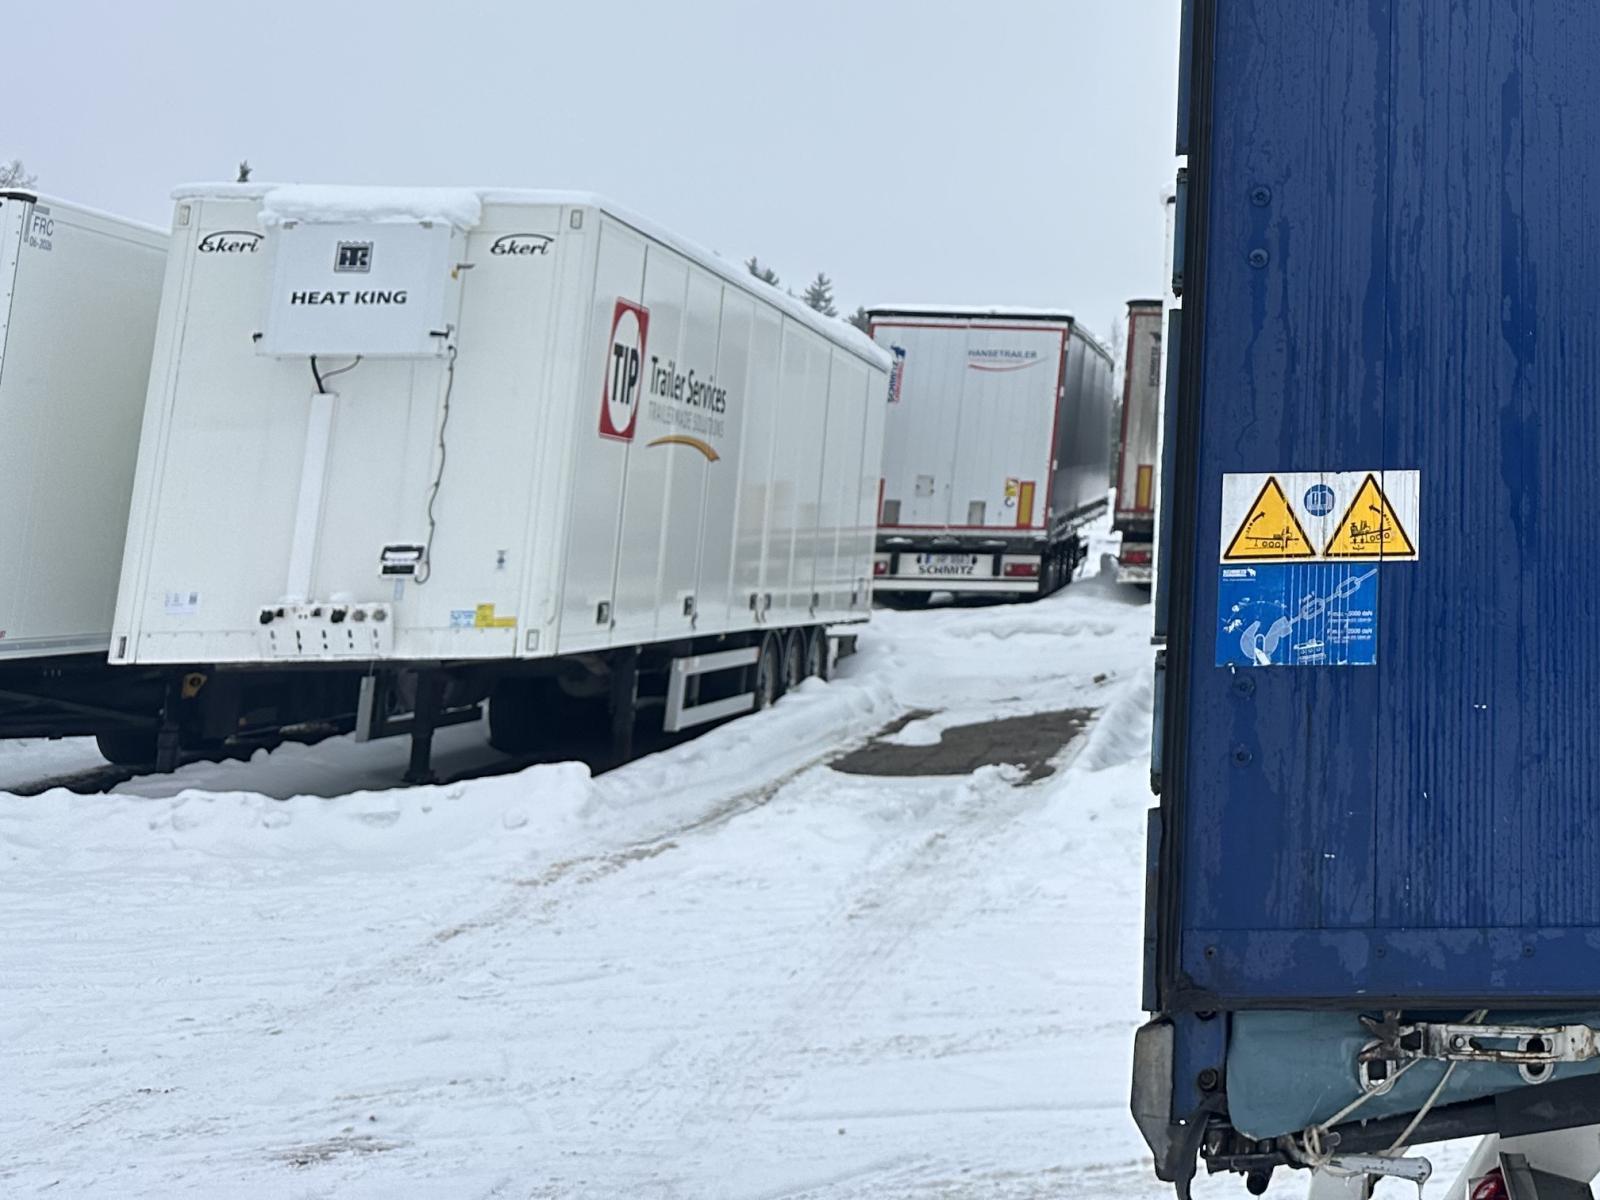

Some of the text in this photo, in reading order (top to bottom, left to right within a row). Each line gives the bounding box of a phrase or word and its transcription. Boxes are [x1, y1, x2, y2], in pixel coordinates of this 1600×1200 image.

[33, 215, 54, 236] FRC
[199, 230, 264, 252] Ekeri
[490, 233, 554, 255] Ekeri
[291, 290, 408, 305] HEAT KING
[612, 342, 640, 404] TIP
[650, 355, 727, 414] Trailer Services
[919, 565, 974, 576] SCHMITZ
